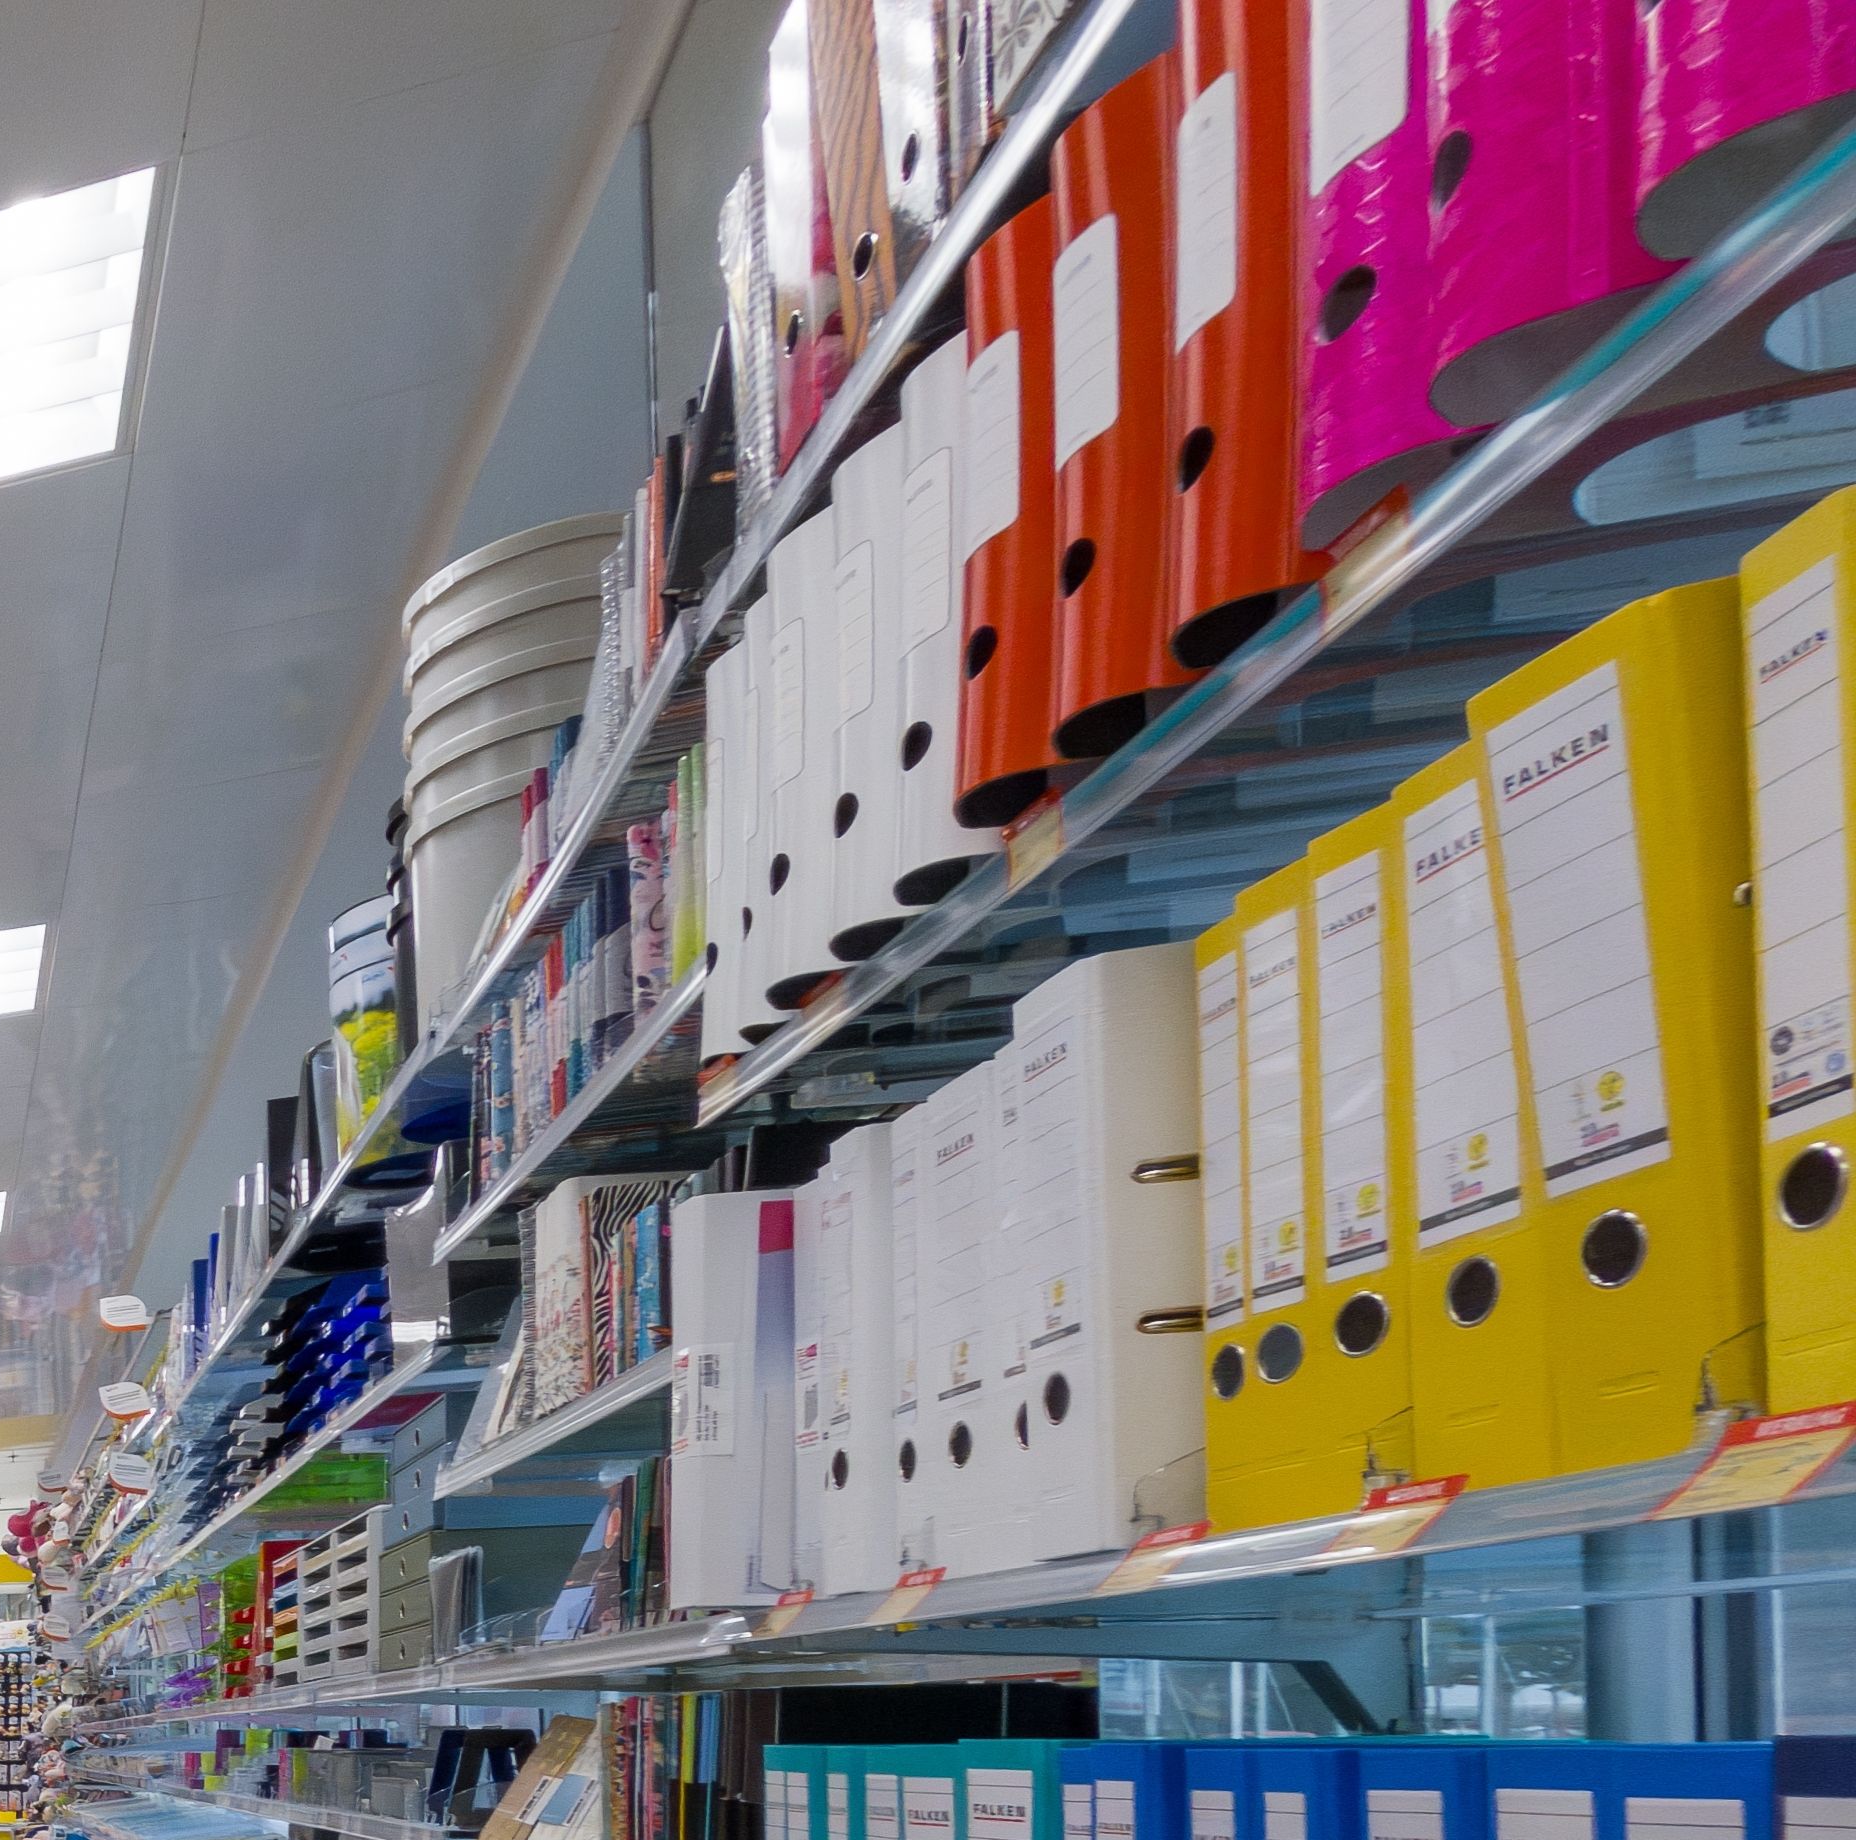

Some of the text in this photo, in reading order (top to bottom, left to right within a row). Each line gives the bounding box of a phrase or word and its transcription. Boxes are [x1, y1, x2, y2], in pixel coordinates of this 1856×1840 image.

[1759, 629, 1829, 680] FALKEN
[1502, 722, 1610, 796] FALKEN
[908, 1809, 951, 1823] FALKEN
[972, 1803, 1026, 1818] FALKEN
